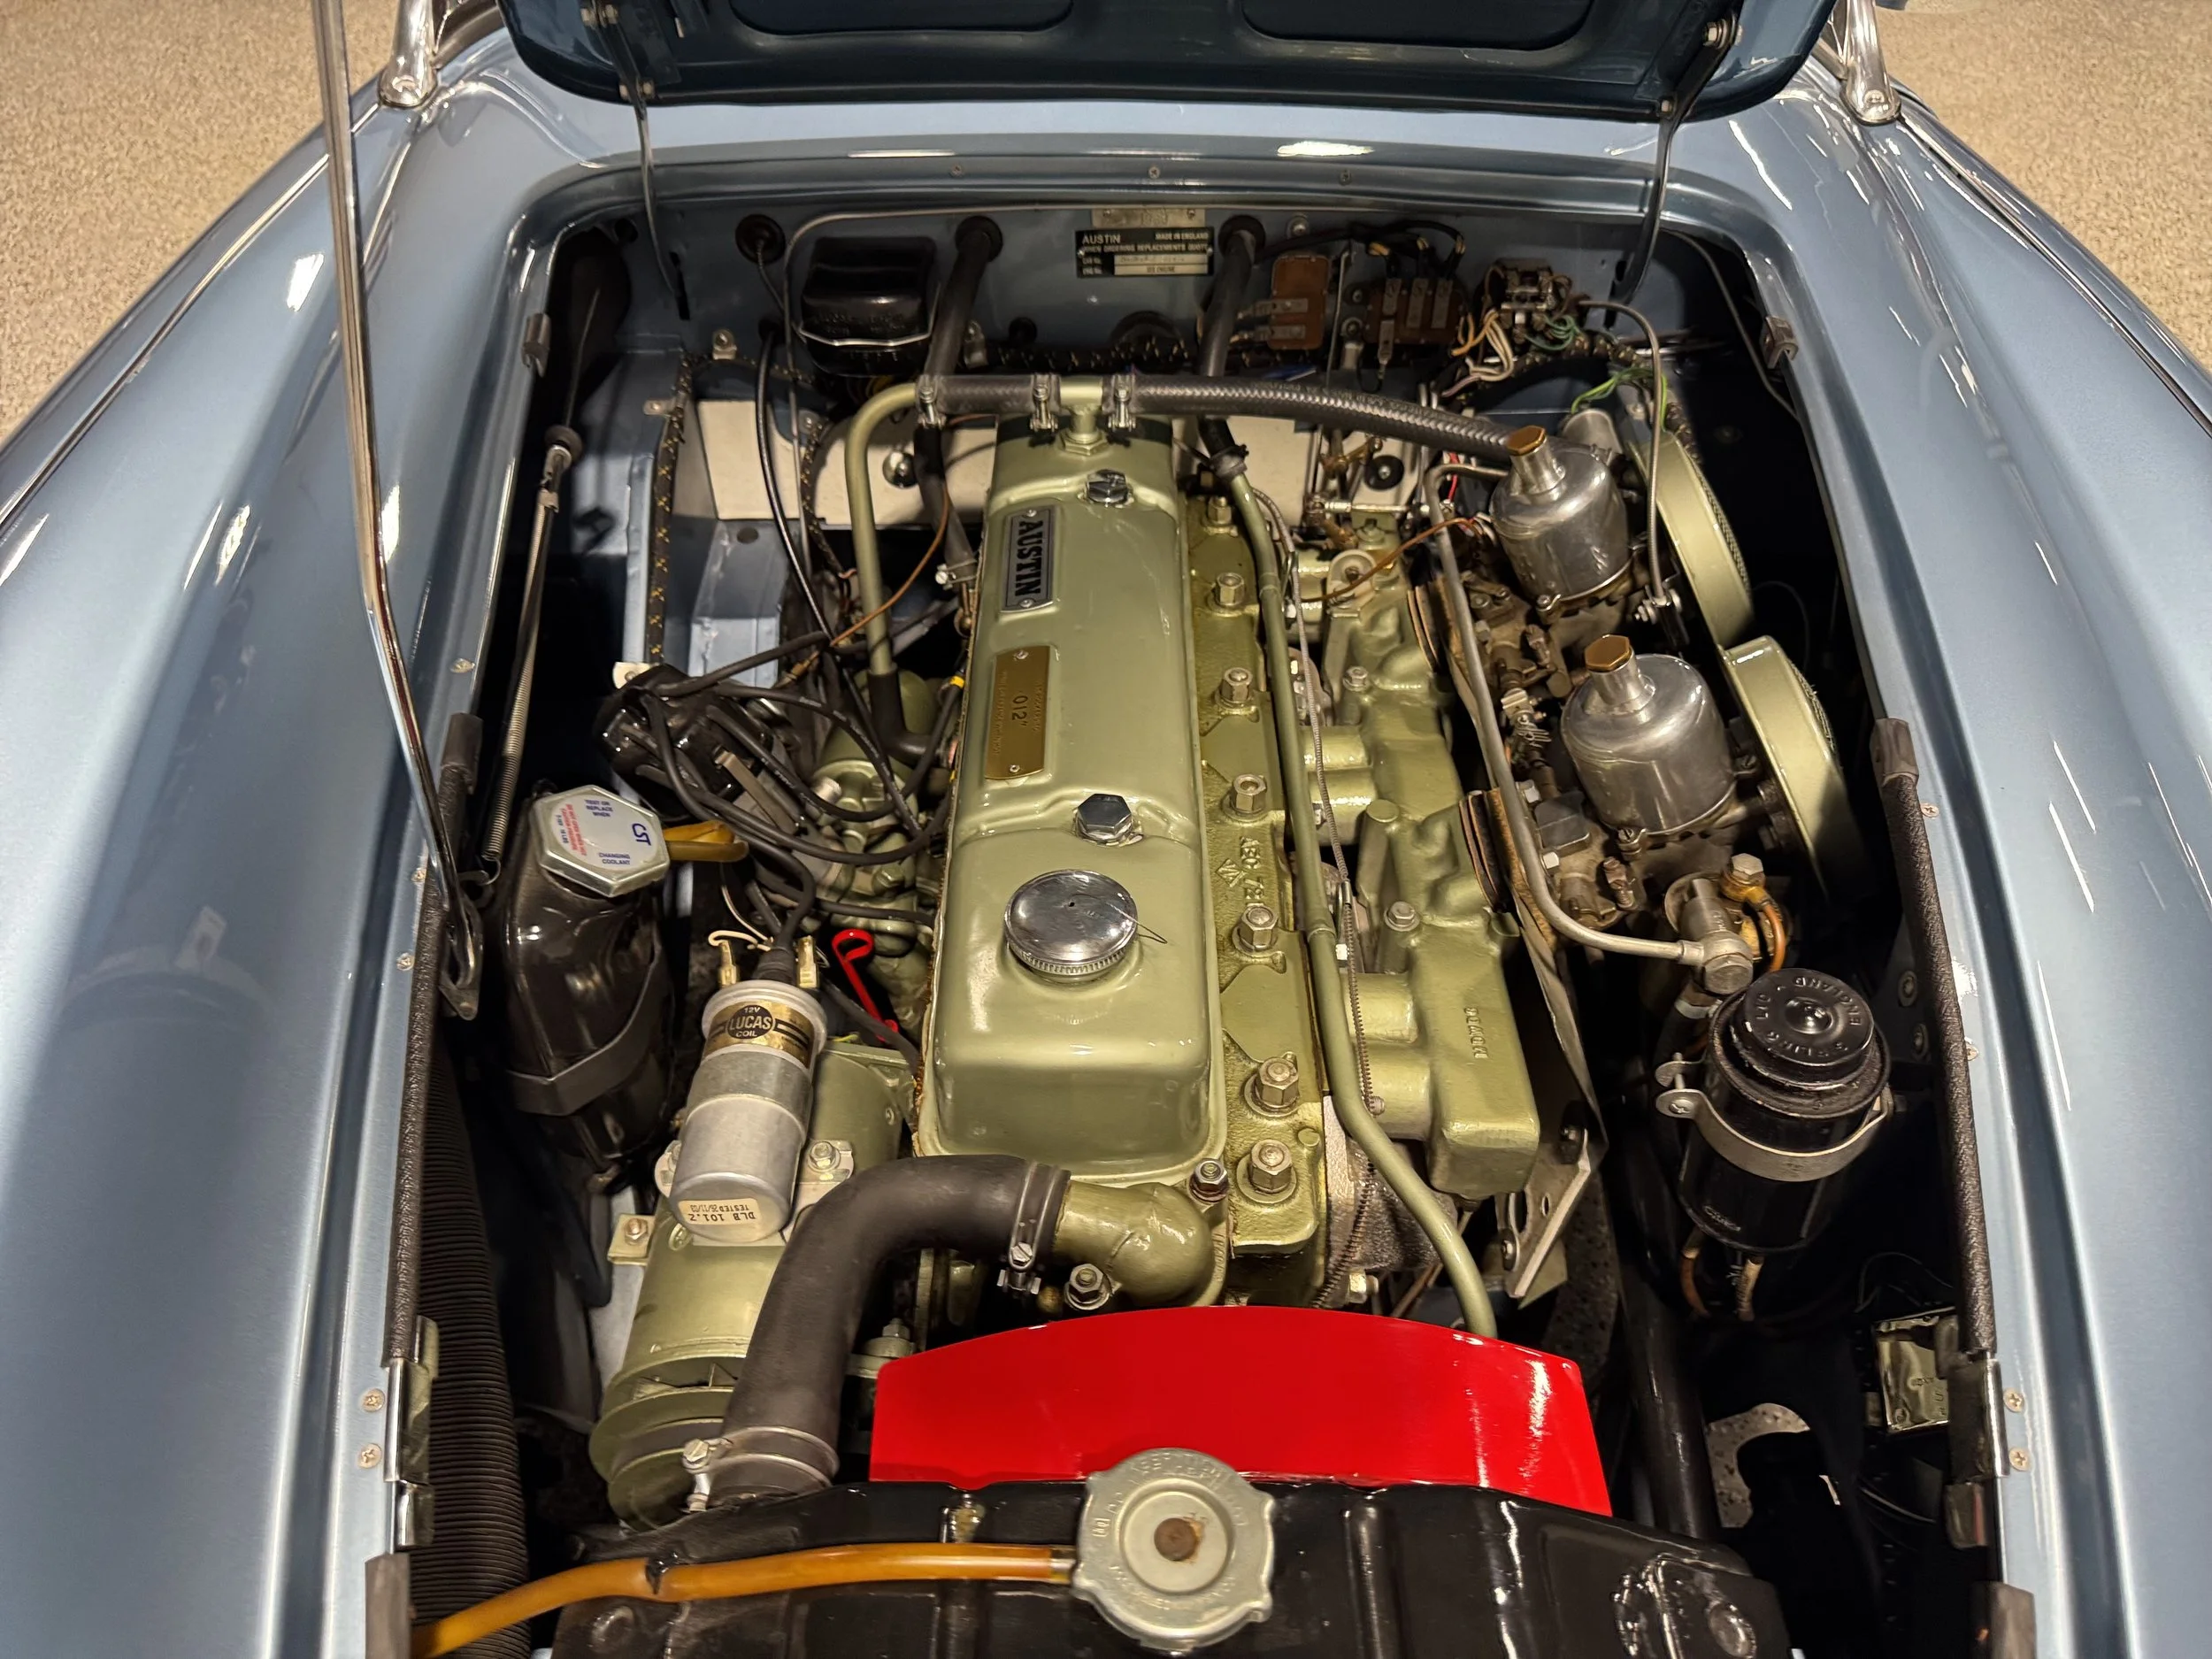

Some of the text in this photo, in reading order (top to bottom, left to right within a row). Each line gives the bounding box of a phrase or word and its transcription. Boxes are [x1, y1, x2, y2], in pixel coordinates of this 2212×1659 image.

[1082, 234, 1121, 244] AUSTIN
[1015, 519, 1043, 597] AUSTIN
[632, 823, 652, 846] CST
[1239, 836, 1261, 870] AEC
[729, 1015, 772, 1031] LUCAS
[718, 1204, 749, 1213] TESTED
[733, 1211, 756, 1221] DLB
